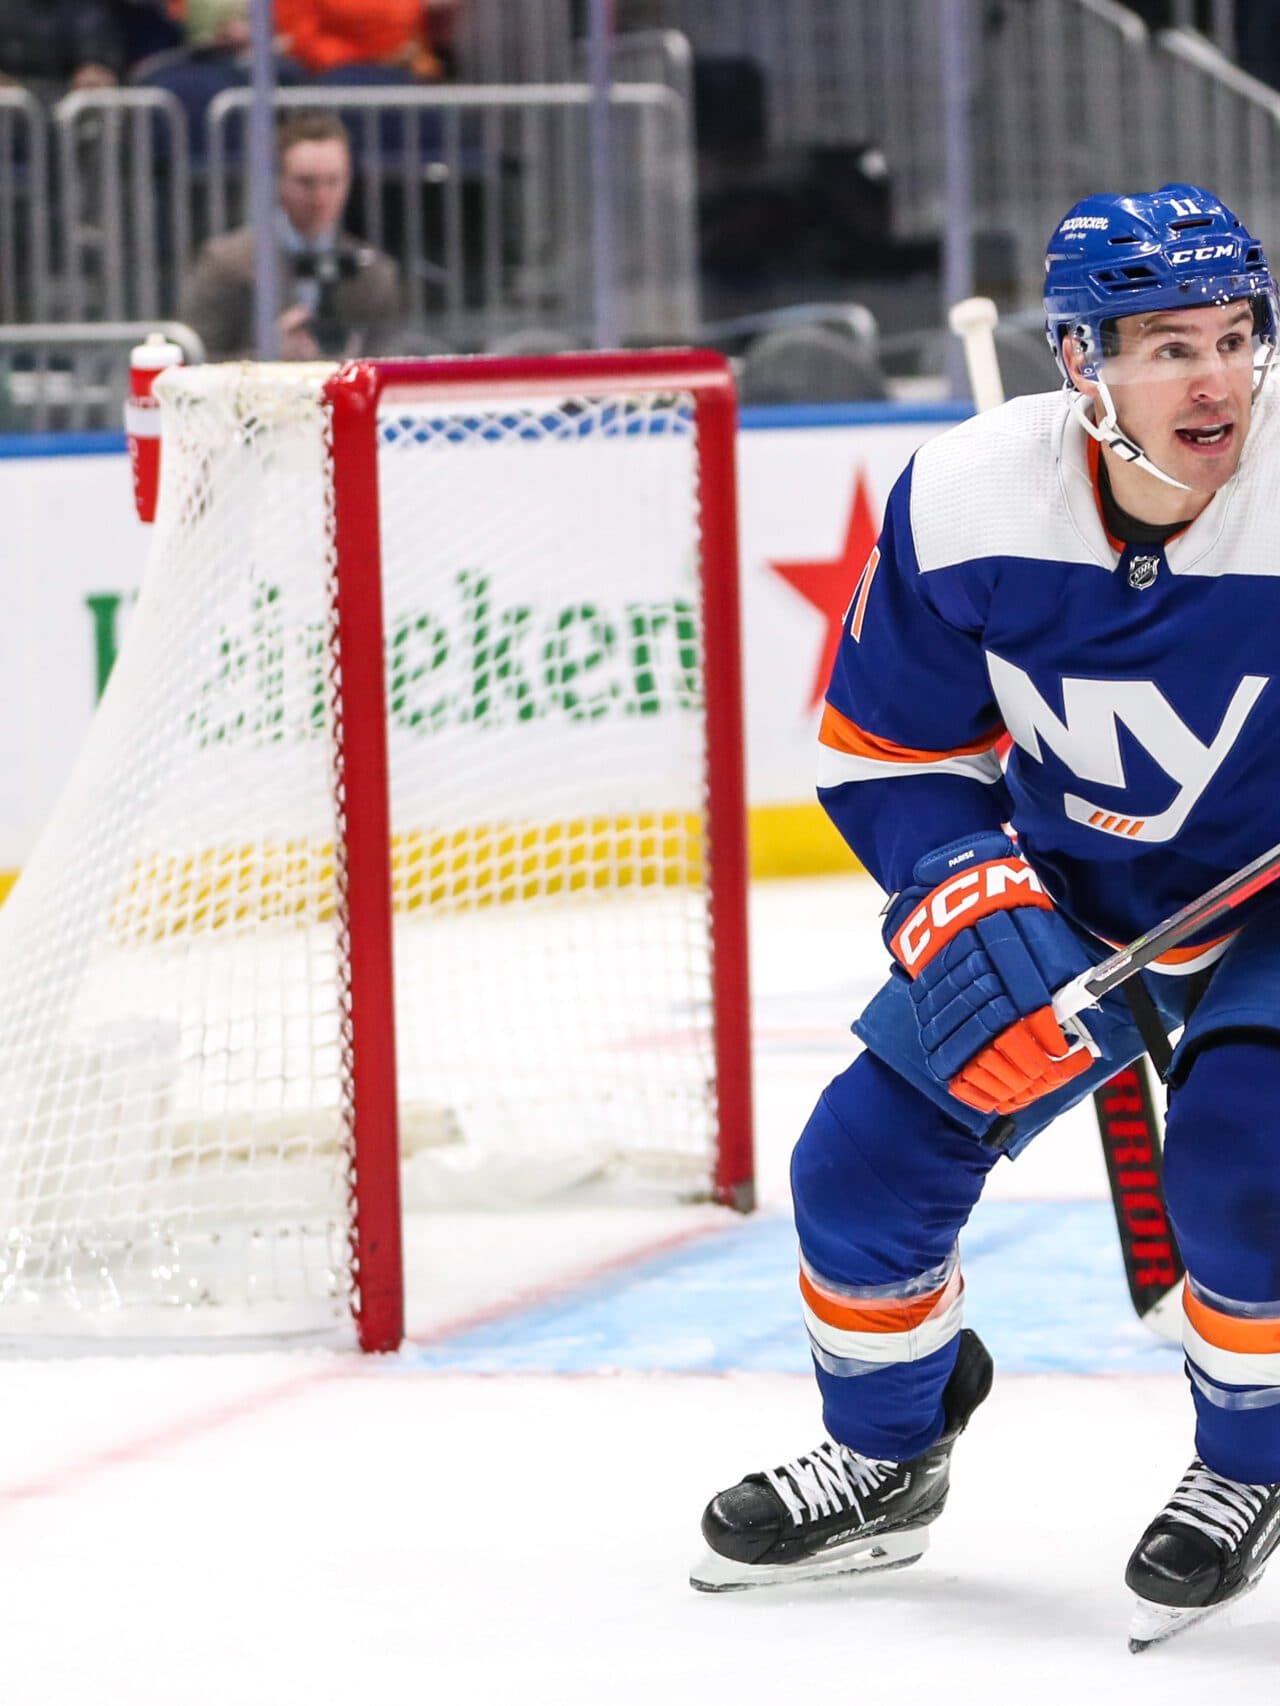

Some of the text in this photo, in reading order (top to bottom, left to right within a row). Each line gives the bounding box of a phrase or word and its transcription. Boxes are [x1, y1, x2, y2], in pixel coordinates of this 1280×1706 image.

[1169, 198, 1202, 217] 11
[1171, 244, 1234, 265] CCM
[900, 864, 1043, 966] CCM
[1103, 1070, 1176, 1288] RRIOR
